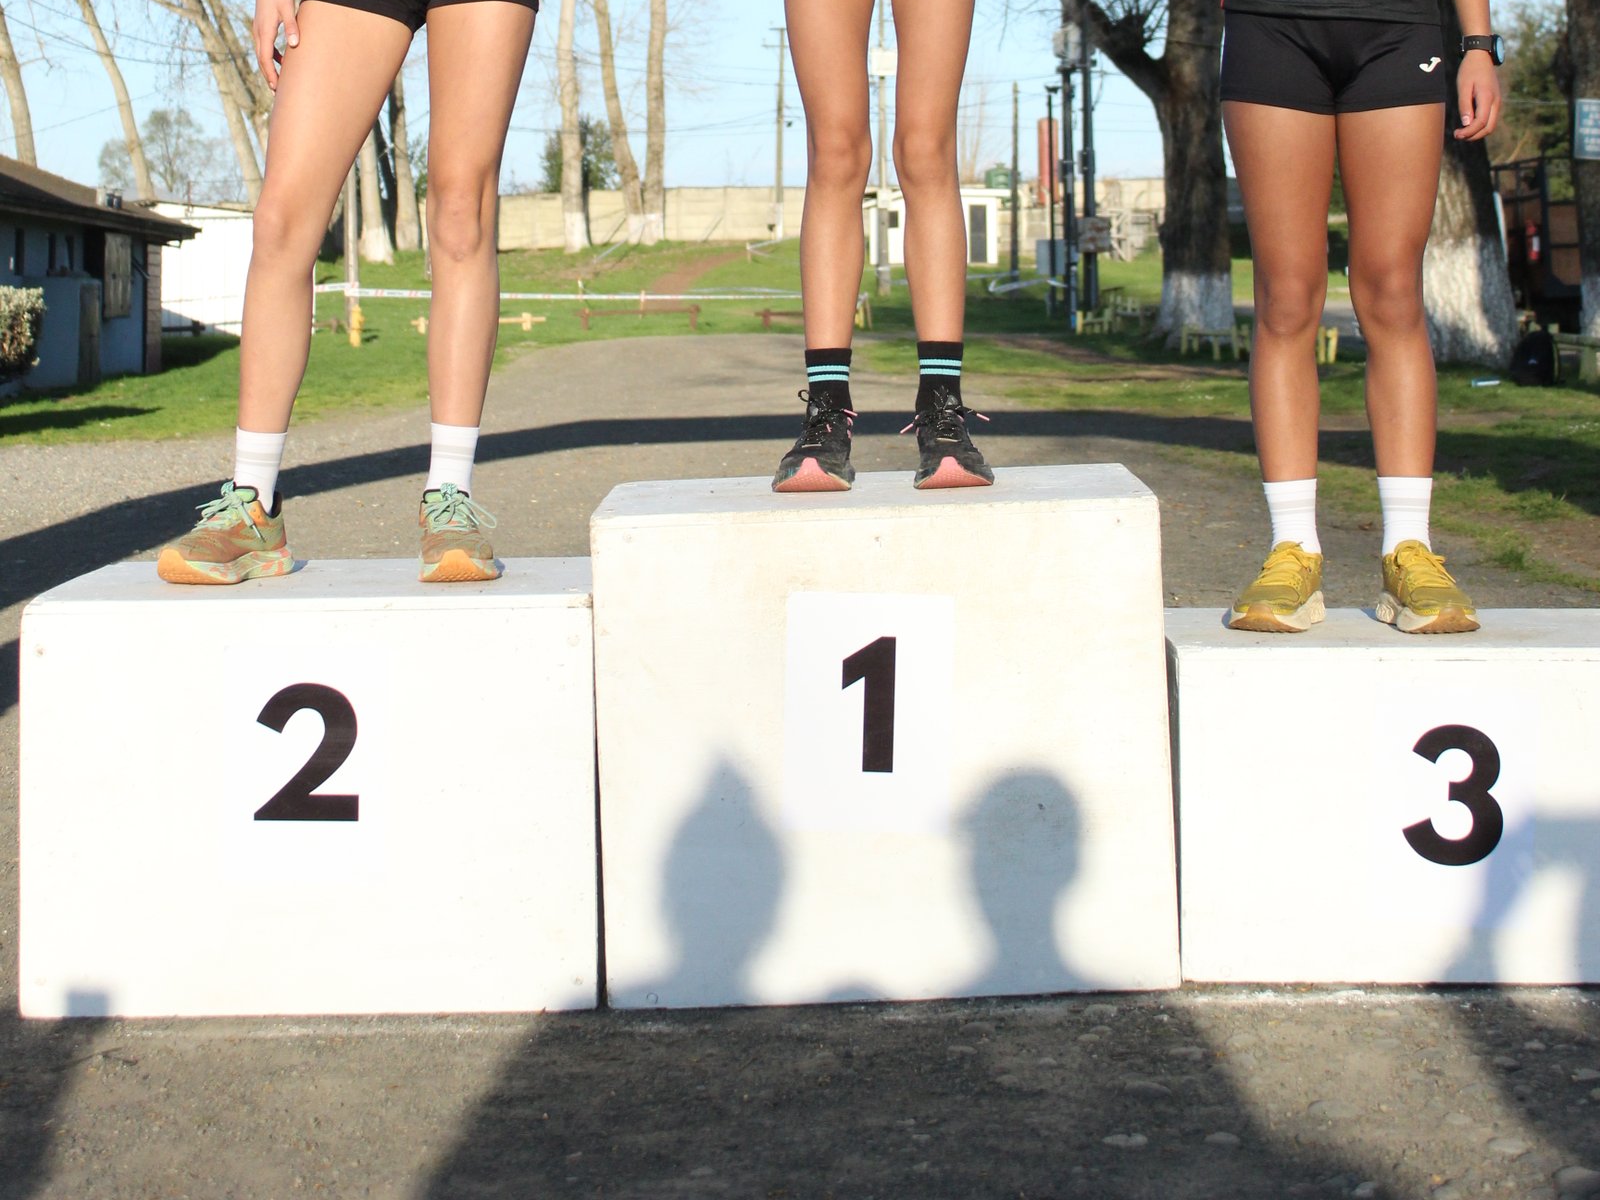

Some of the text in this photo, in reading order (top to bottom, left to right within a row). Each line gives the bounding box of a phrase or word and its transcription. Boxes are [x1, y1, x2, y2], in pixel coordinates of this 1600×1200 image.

[254, 682, 360, 822] 2
[841, 636, 896, 774] 1
[1402, 724, 1504, 867] 3
